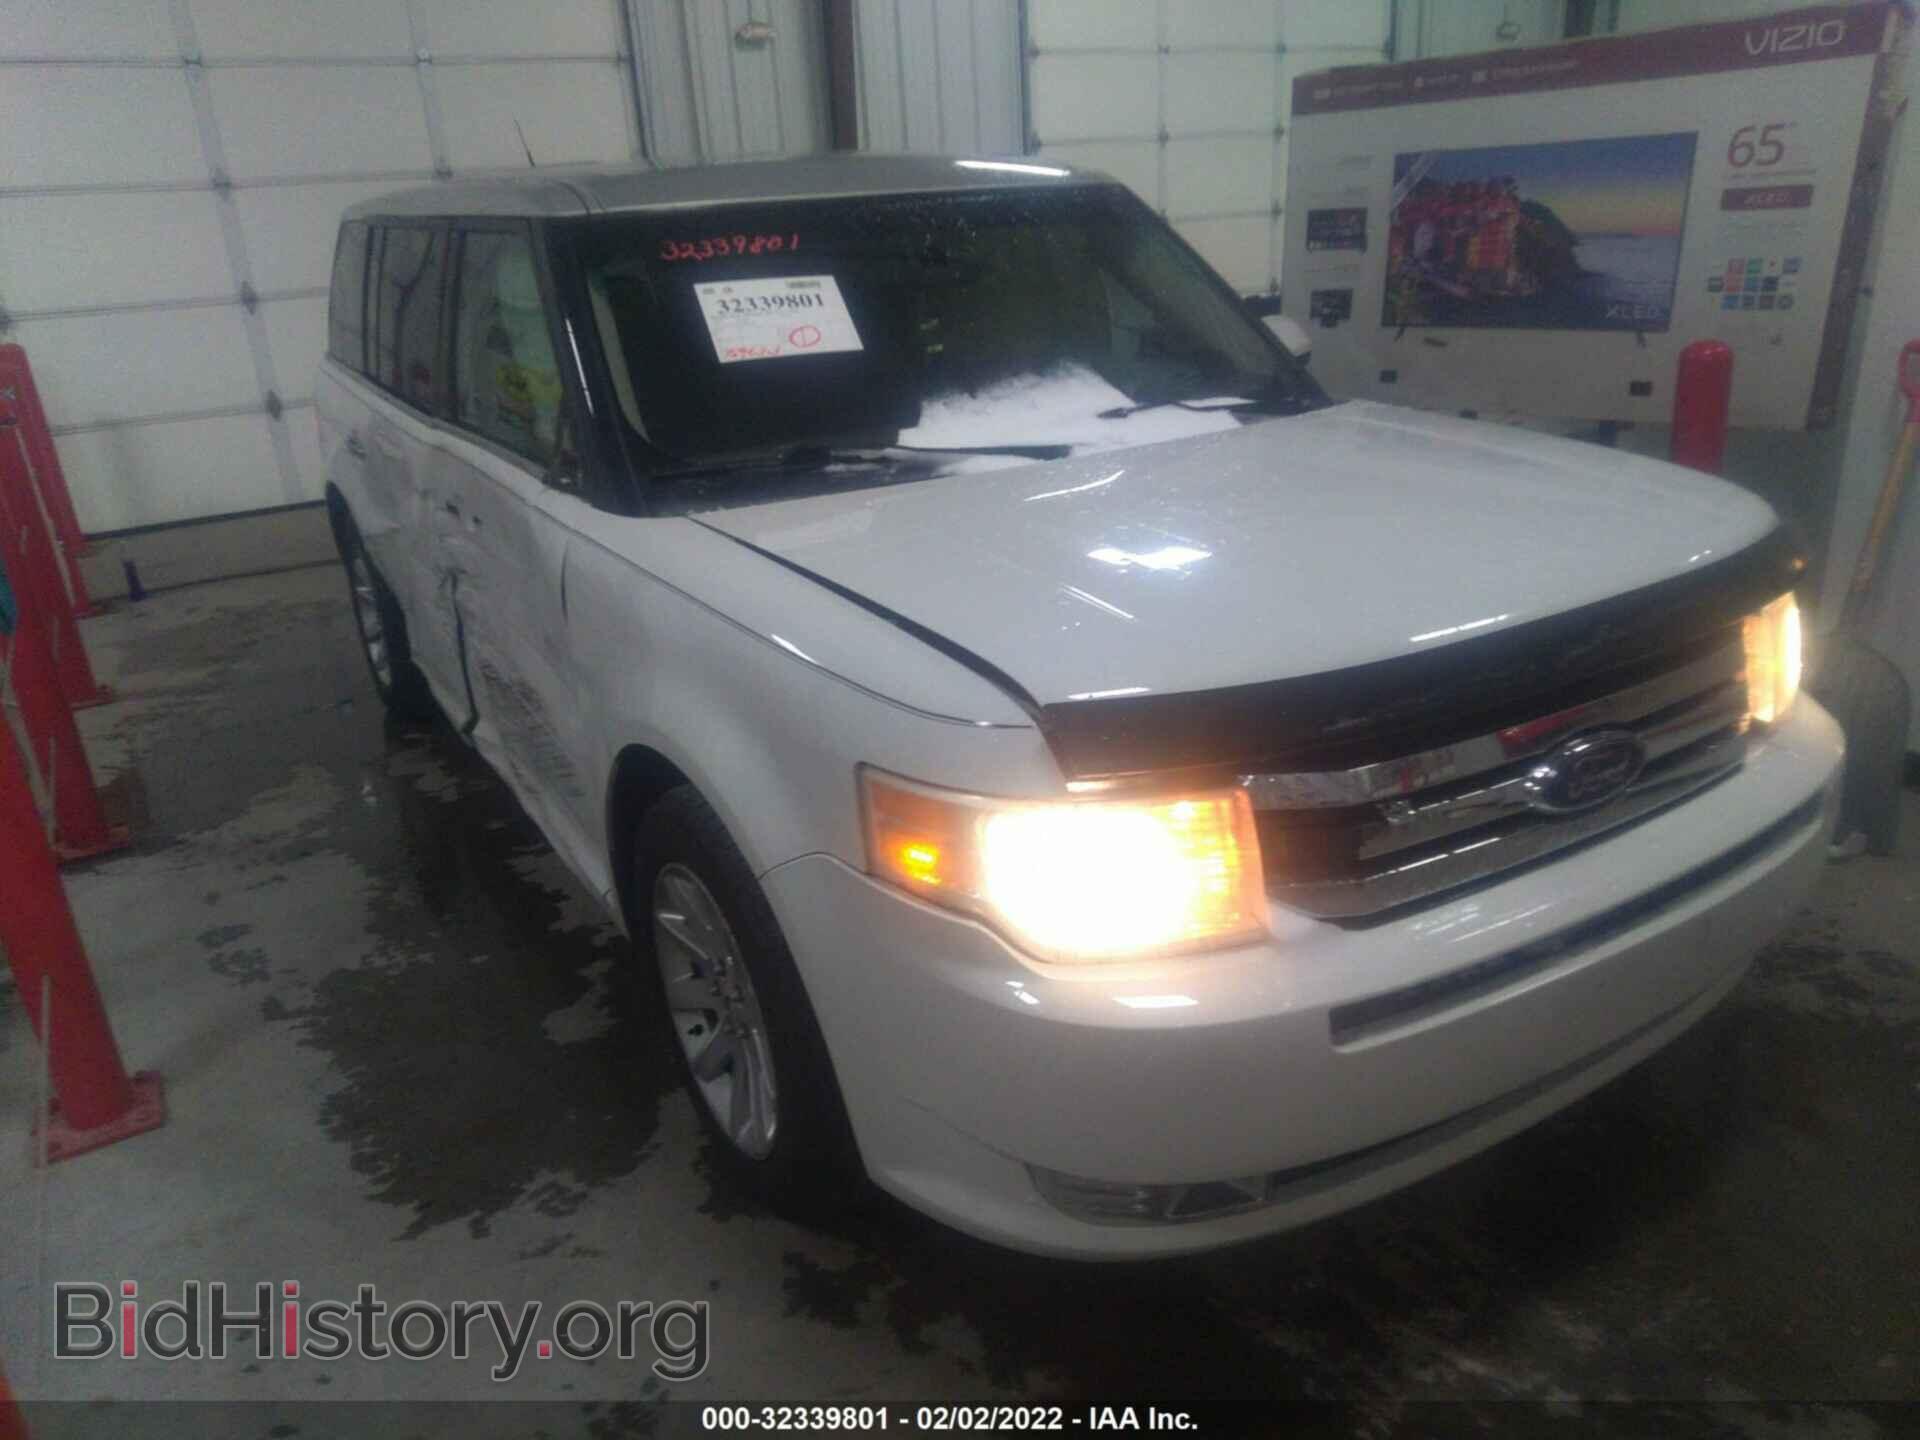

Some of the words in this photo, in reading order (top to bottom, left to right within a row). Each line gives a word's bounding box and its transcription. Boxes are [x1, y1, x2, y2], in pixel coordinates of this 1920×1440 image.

[1744, 19, 1847, 56] VIZIO
[661, 233, 800, 261] 32339801
[717, 293, 824, 314] 32339801
